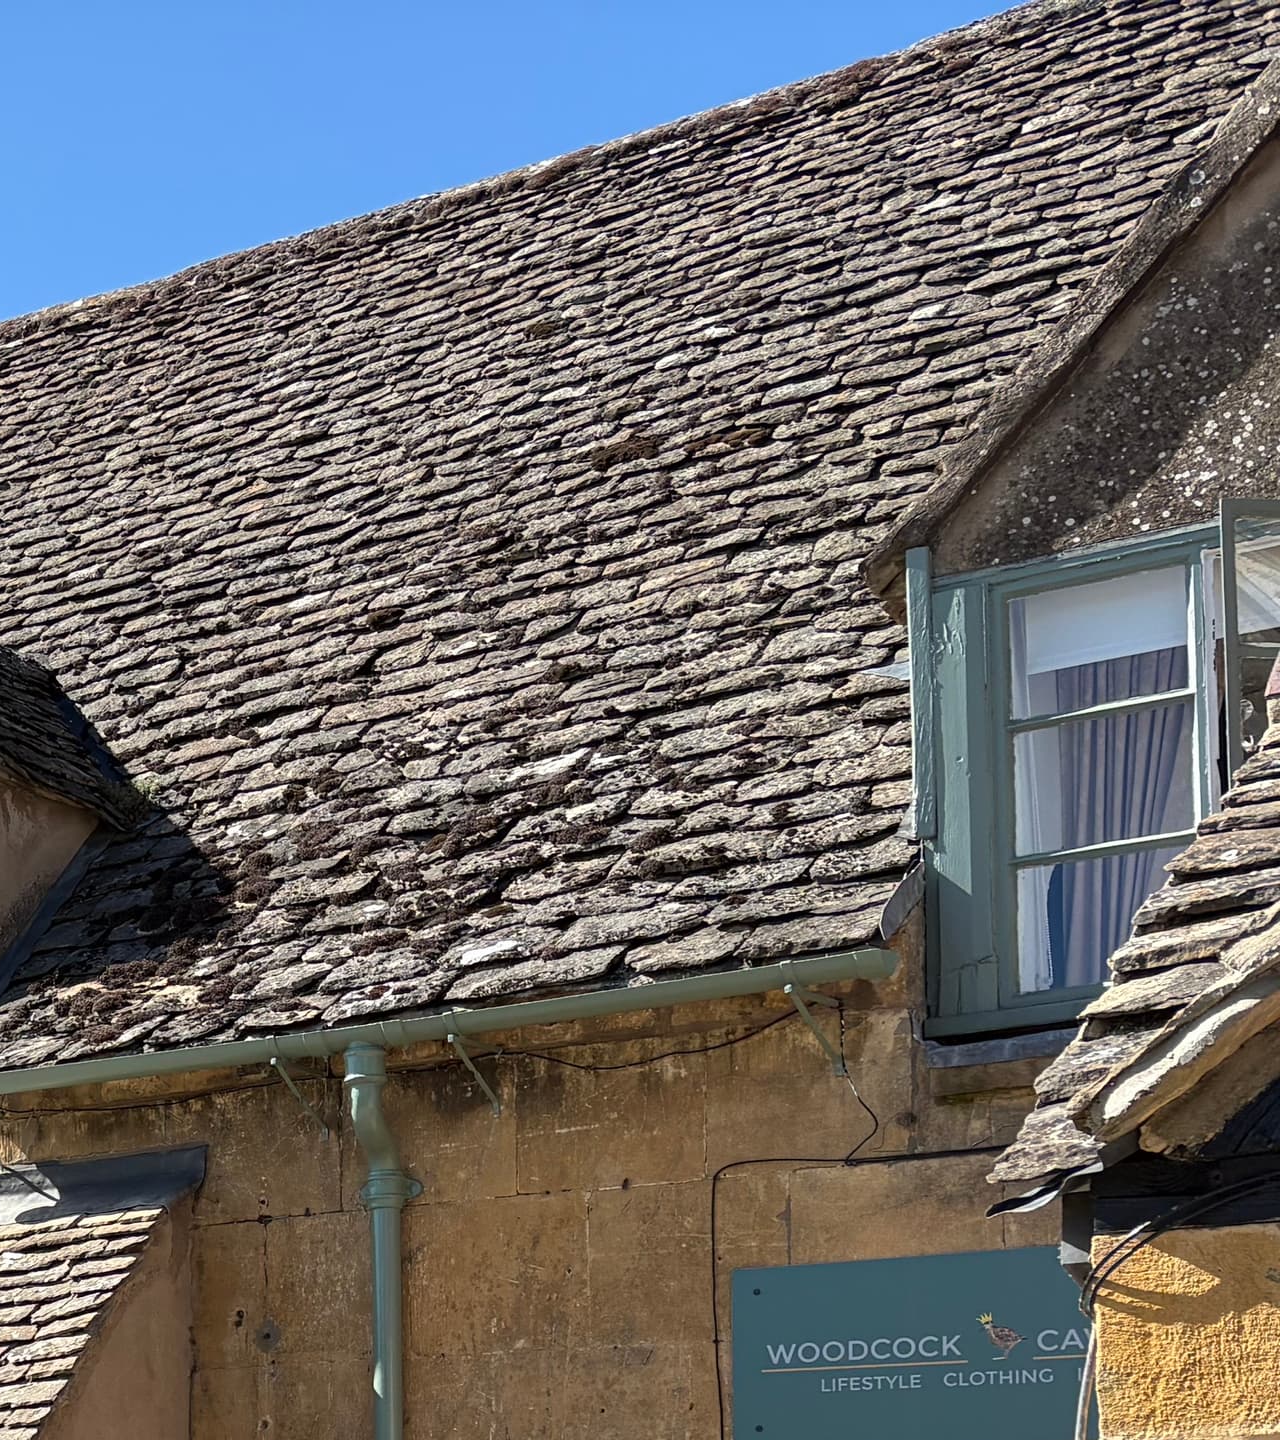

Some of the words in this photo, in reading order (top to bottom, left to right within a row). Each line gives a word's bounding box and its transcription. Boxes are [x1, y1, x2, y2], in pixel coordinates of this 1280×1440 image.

[766, 1334, 962, 1364] WOODCOCK
[820, 1374, 922, 1392] LIFESTYLE
[943, 1367, 1054, 1388] CLOTHING
